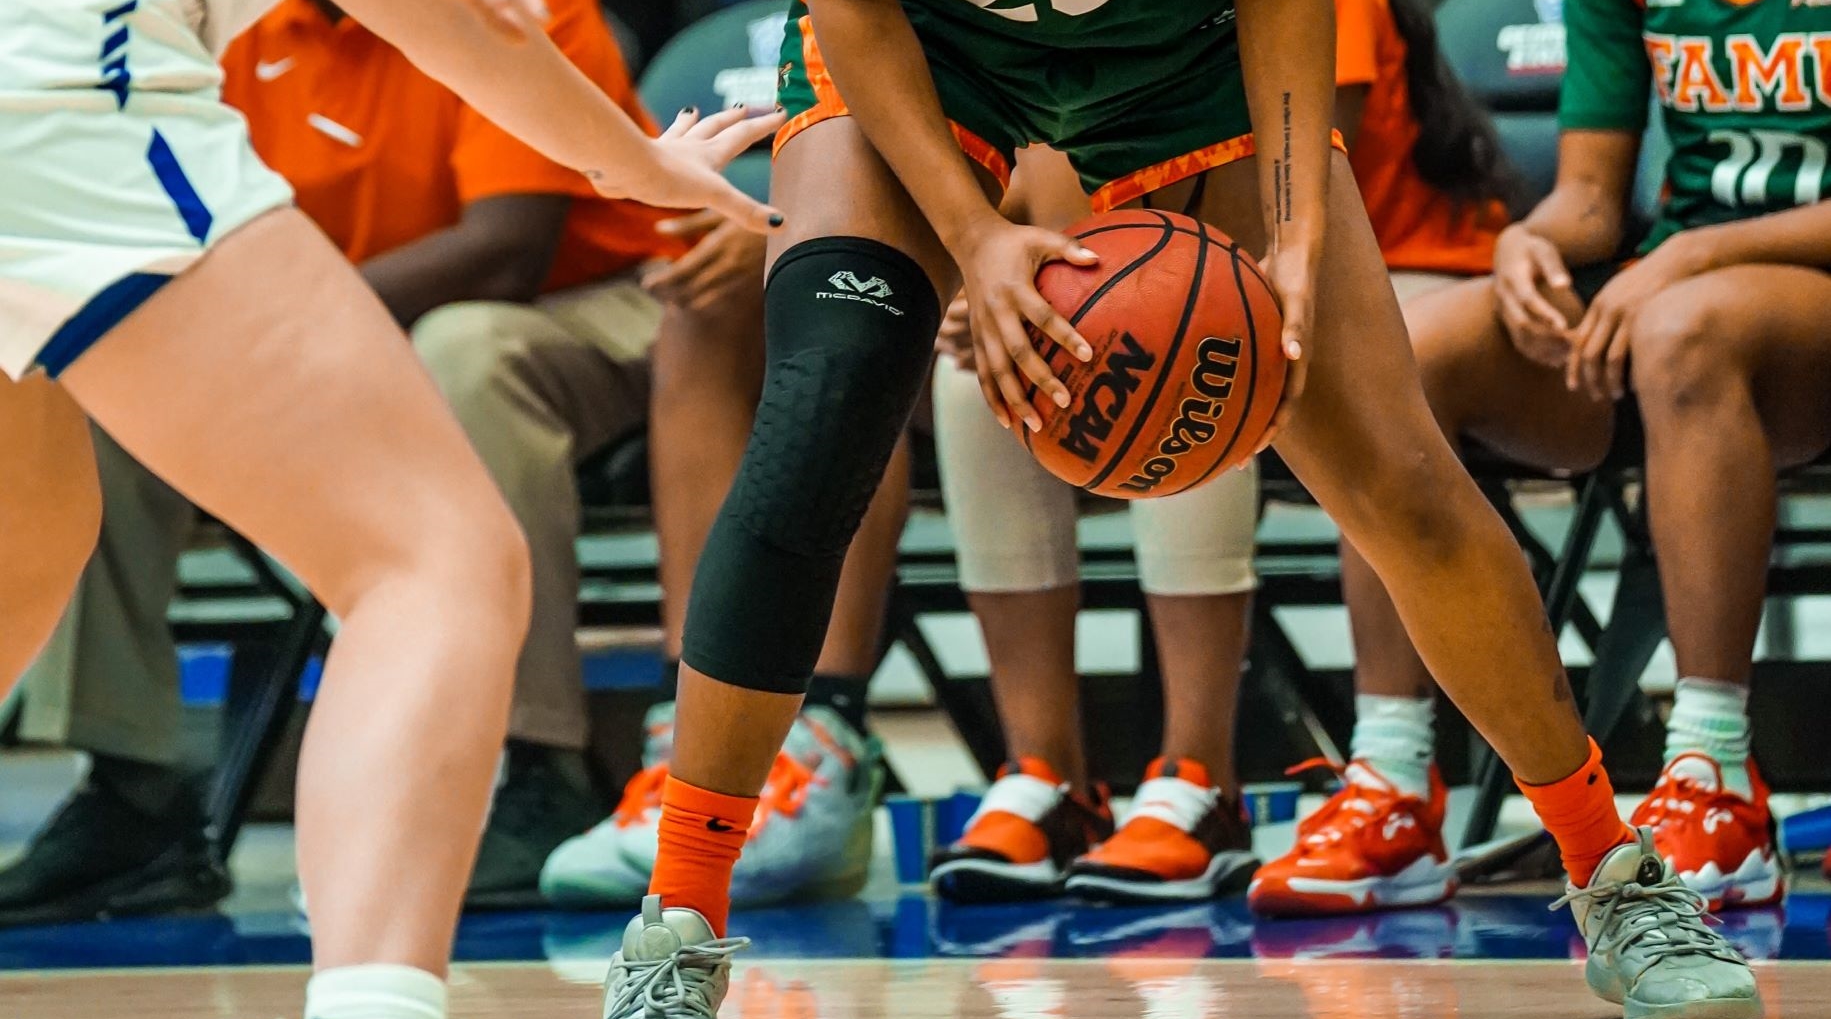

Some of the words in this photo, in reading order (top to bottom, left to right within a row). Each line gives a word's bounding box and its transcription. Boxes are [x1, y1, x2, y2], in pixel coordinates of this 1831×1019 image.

[1706, 129, 1827, 208] 10
[1057, 330, 1156, 464] NCAA
[1117, 335, 1243, 494] Wilson
